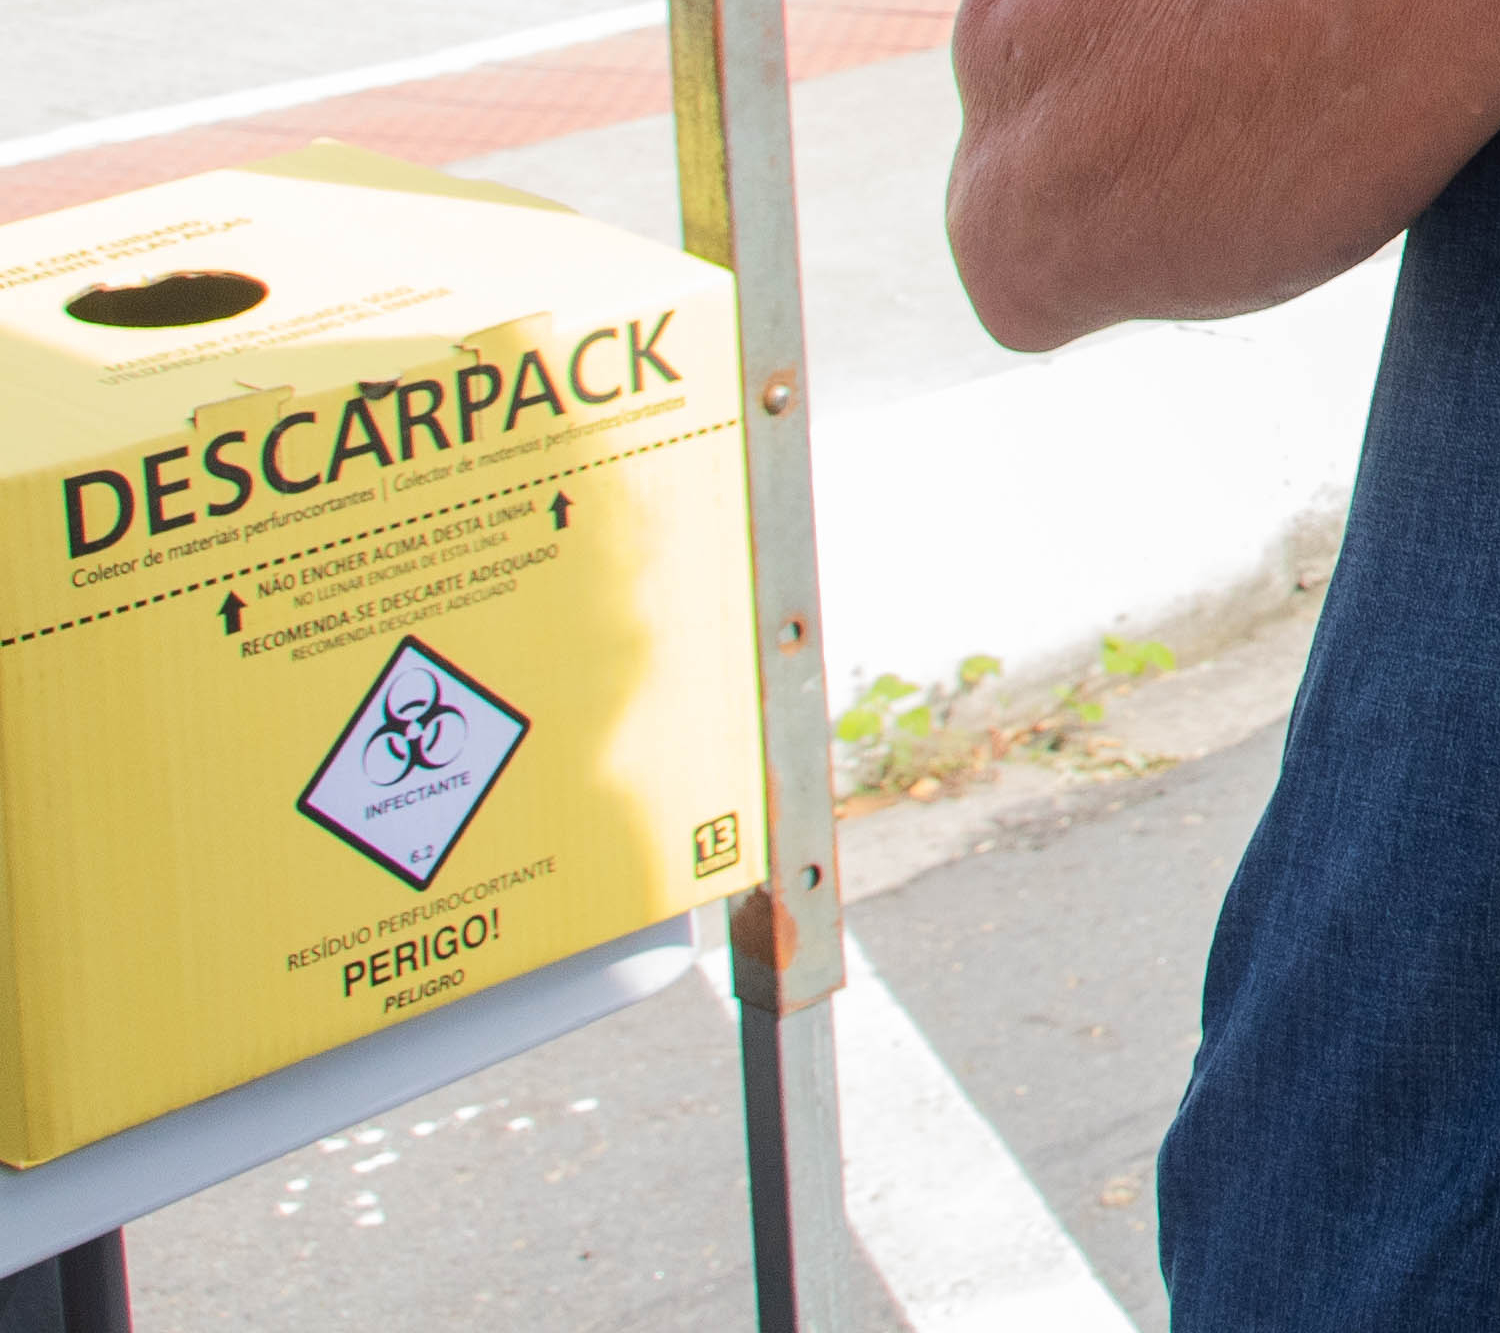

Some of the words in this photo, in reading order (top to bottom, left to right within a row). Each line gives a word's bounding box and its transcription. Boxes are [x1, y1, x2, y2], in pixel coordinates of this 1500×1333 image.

[63, 309, 683, 560] DESCARPACK
[71, 555, 138, 589] Coletor
[143, 548, 164, 569] de
[167, 526, 240, 562] materiais
[243, 487, 376, 543] perfurocortantes
[257, 571, 297, 599] NÃO
[302, 550, 369, 586] ENCHER
[371, 534, 429, 564] ACIMA
[432, 516, 485, 547] DESTA
[487, 499, 537, 528] LINHA
[241, 601, 377, 660] RECOMENDA-SE
[380, 572, 465, 615] DESCARTE
[467, 542, 560, 585] ADEQUADO
[317, 573, 366, 602] LLENAR
[290, 624, 377, 662] RECOMENDA
[378, 603, 444, 632] DESCARTE
[365, 770, 473, 821] INFECTANTE
[410, 843, 436, 865] 6.2
[696, 815, 737, 860] 13
[286, 925, 372, 972] RESÍDUO
[377, 855, 558, 938] PERFUROCORTANTE
[341, 905, 501, 999] PERIGO!
[382, 968, 466, 1015] PELIGRO
